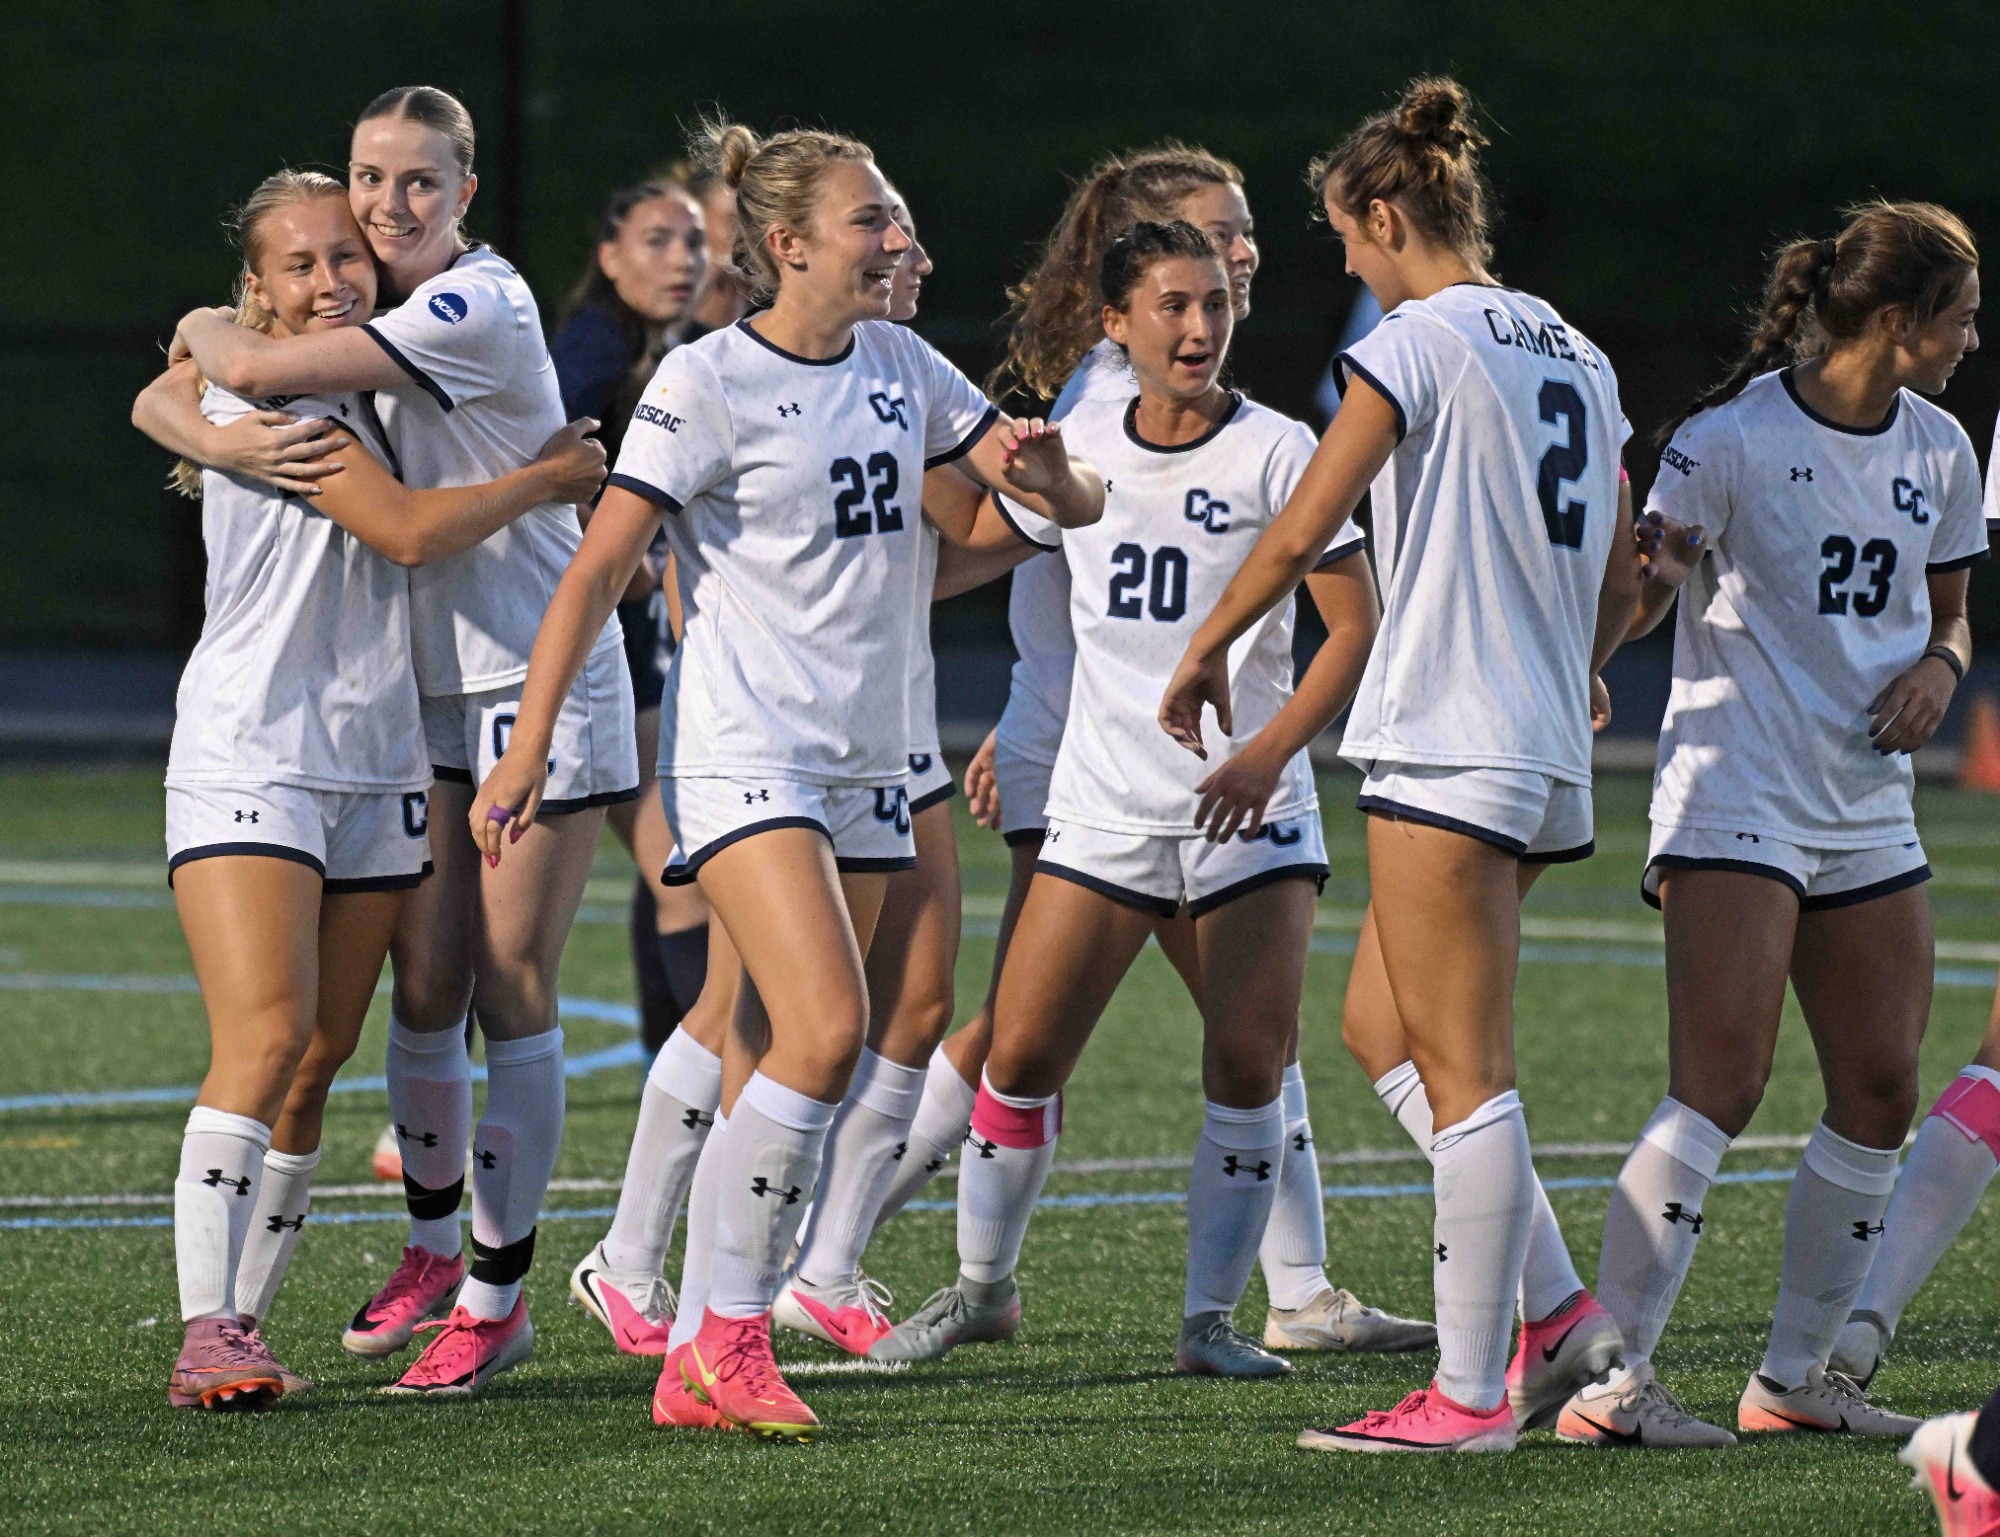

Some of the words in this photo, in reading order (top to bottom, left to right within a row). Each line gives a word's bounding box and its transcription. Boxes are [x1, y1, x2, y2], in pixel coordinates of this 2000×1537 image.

[430, 296, 461, 322] NCAA
[829, 451, 904, 539] 22
[1537, 377, 1588, 552] 2
[1892, 476, 1930, 525] CC
[1184, 487, 1231, 535] CC
[1106, 541, 1189, 623] 20
[1818, 533, 1898, 619] 23
